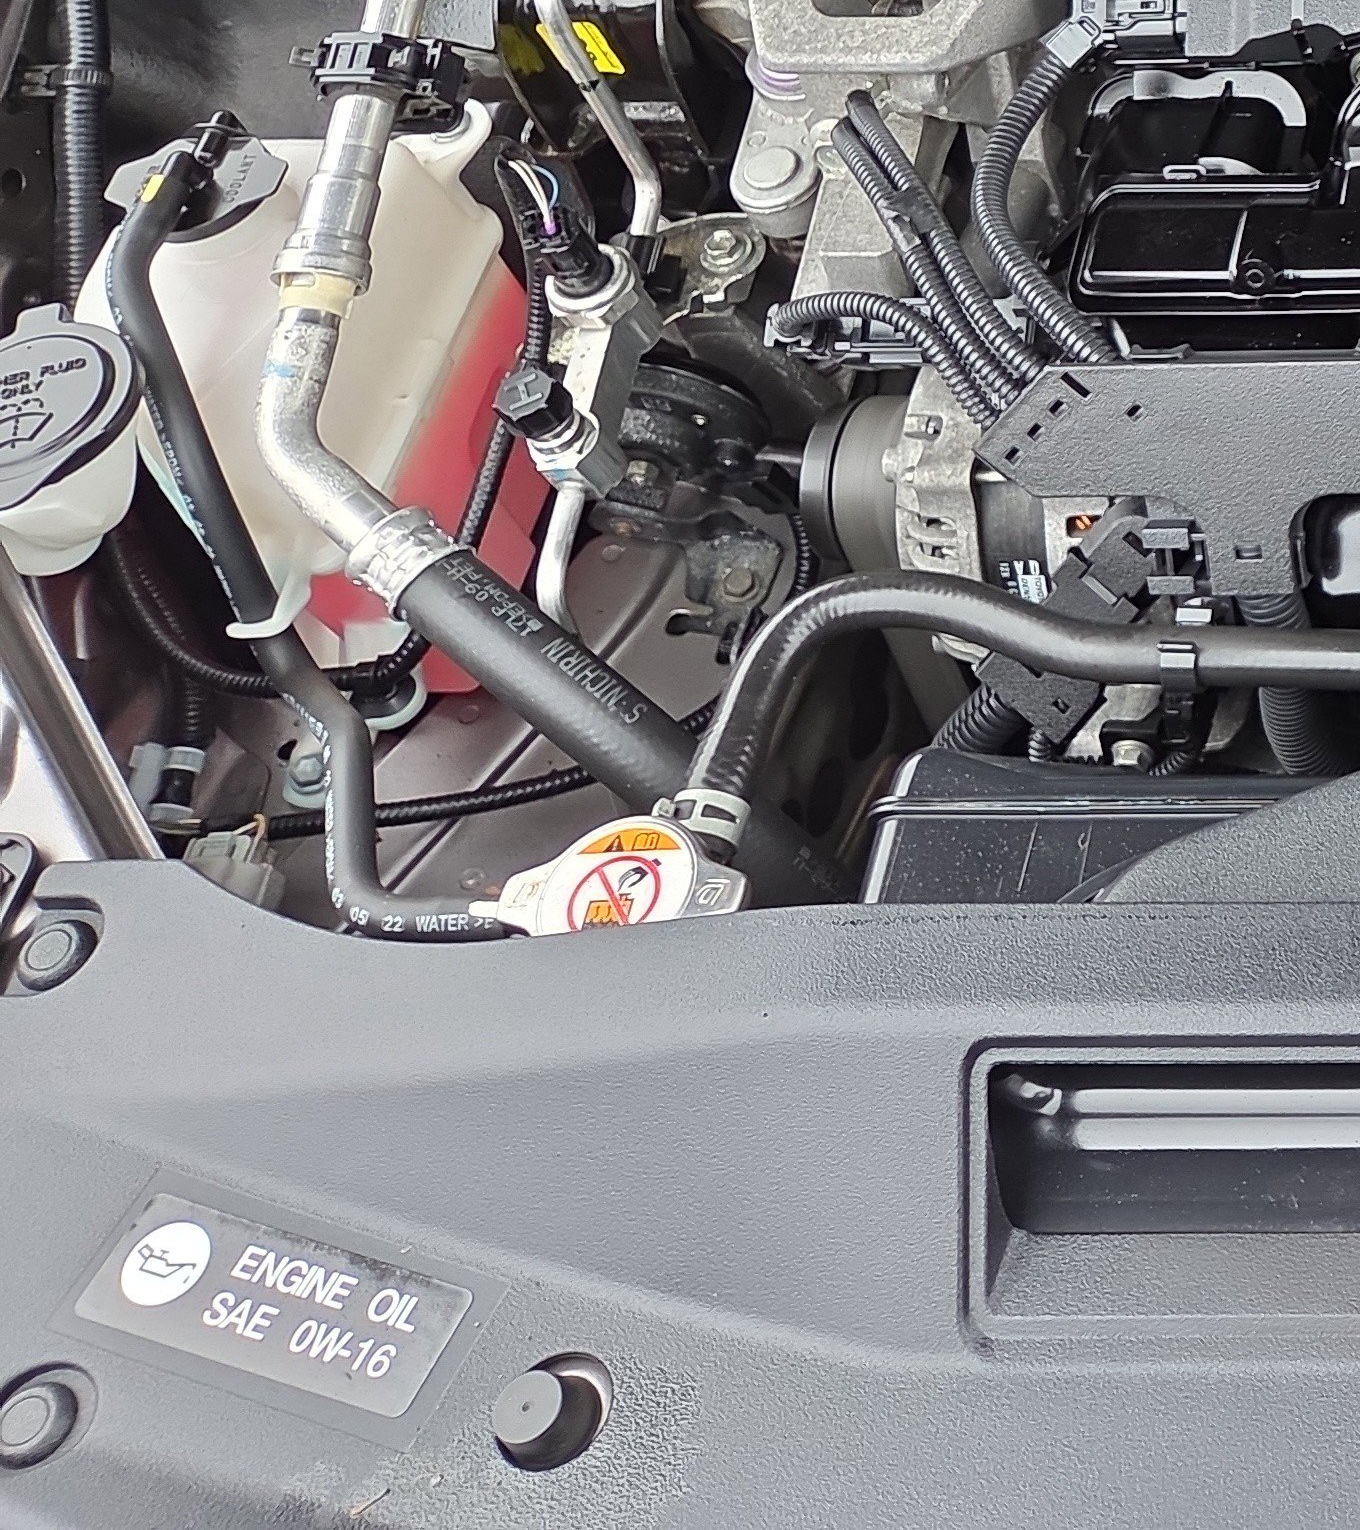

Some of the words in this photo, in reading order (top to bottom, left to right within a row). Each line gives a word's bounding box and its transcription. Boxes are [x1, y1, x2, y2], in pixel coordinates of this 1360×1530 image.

[224, 153, 255, 204] COOLANT
[0, 371, 31, 386] ER
[40, 357, 87, 378] FLUID
[1, 379, 45, 400] ONLY
[503, 372, 543, 411] H
[381, 915, 406, 933] 22
[415, 913, 470, 933] WATER
[230, 1244, 359, 1310] ENGINE
[367, 1288, 419, 1334] OIL
[202, 1291, 280, 1342] SAE
[288, 1319, 397, 1380] 0W-16
